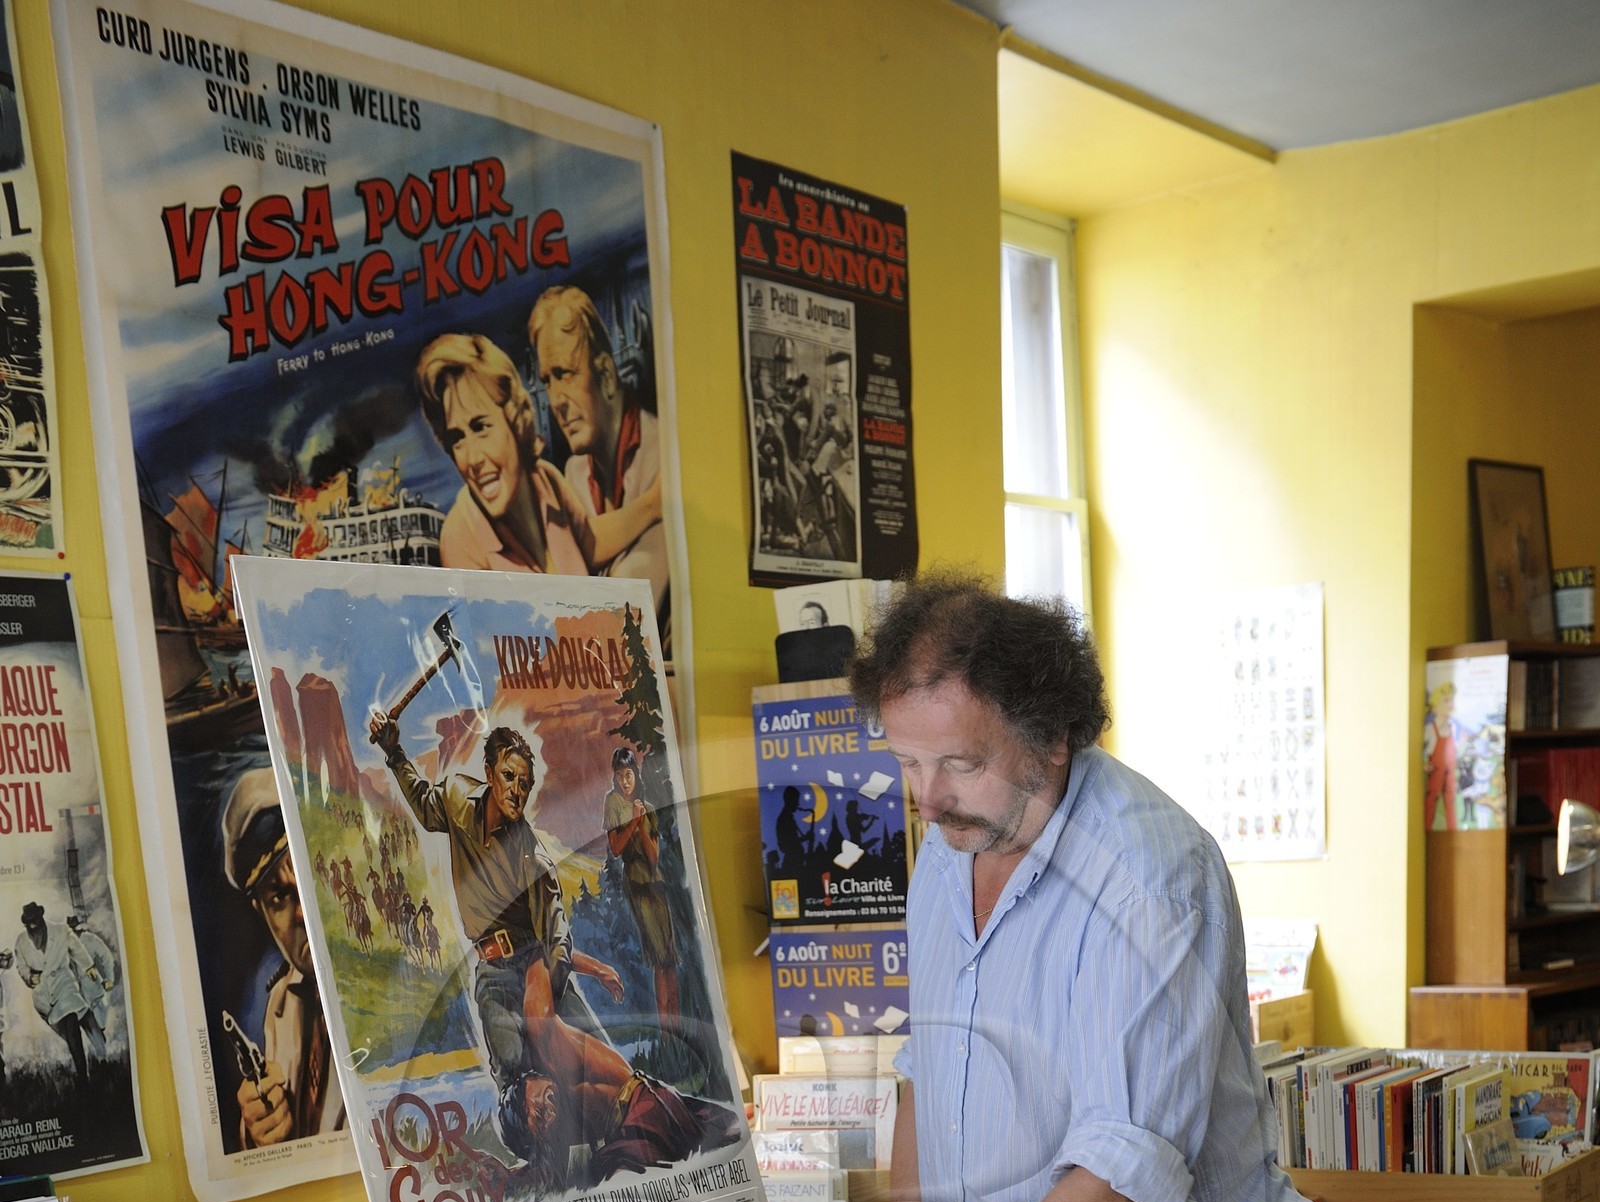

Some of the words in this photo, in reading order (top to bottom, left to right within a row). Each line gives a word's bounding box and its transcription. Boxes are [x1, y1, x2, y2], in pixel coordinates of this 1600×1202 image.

[97, 8, 153, 55] CURD
[160, 27, 250, 86] JURGENS
[277, 63, 340, 110] ORSON
[348, 83, 421, 131] WELLES
[205, 79, 272, 128] SYLVIA
[279, 101, 331, 144] SYMS
[222, 134, 265, 162] LEWIS
[275, 149, 328, 177] GILBERT
[356, 157, 514, 246] POUR
[737, 176, 790, 226] LA
[794, 193, 905, 261] BANDE
[740, 223, 768, 264] A
[774, 230, 905, 300] BONNOT
[218, 208, 571, 365] HONG-KONG
[747, 282, 763, 308] Le
[770, 287, 799, 318] Petit
[806, 298, 851, 330] Journal
[493, 635, 549, 690] KIRK
[545, 636, 634, 690] DOUGLAS
[759, 716, 769, 733] 6
[771, 709, 811, 732] AOÛT
[814, 707, 857, 727] NUIT
[761, 738, 789, 760] DU
[795, 732, 860, 758] LIVRE
[840, 876, 893, 894] Charité
[775, 946, 785, 962] 6
[787, 941, 828, 961] AOÛT
[831, 943, 872, 959] NUIT
[777, 968, 807, 988] DU
[813, 967, 875, 987] LIVRE
[812, 1083, 837, 1092] KONK
[760, 1093, 791, 1117] VIVE
[792, 1093, 808, 1117] LE
[36, 1118, 62, 1133] REINL
[31, 1135, 75, 1154] WALLACE
[434, 1153, 473, 1185] des
[728, 1158, 751, 1185] ABEL
[779, 1183, 828, 1198] FAIZANT
